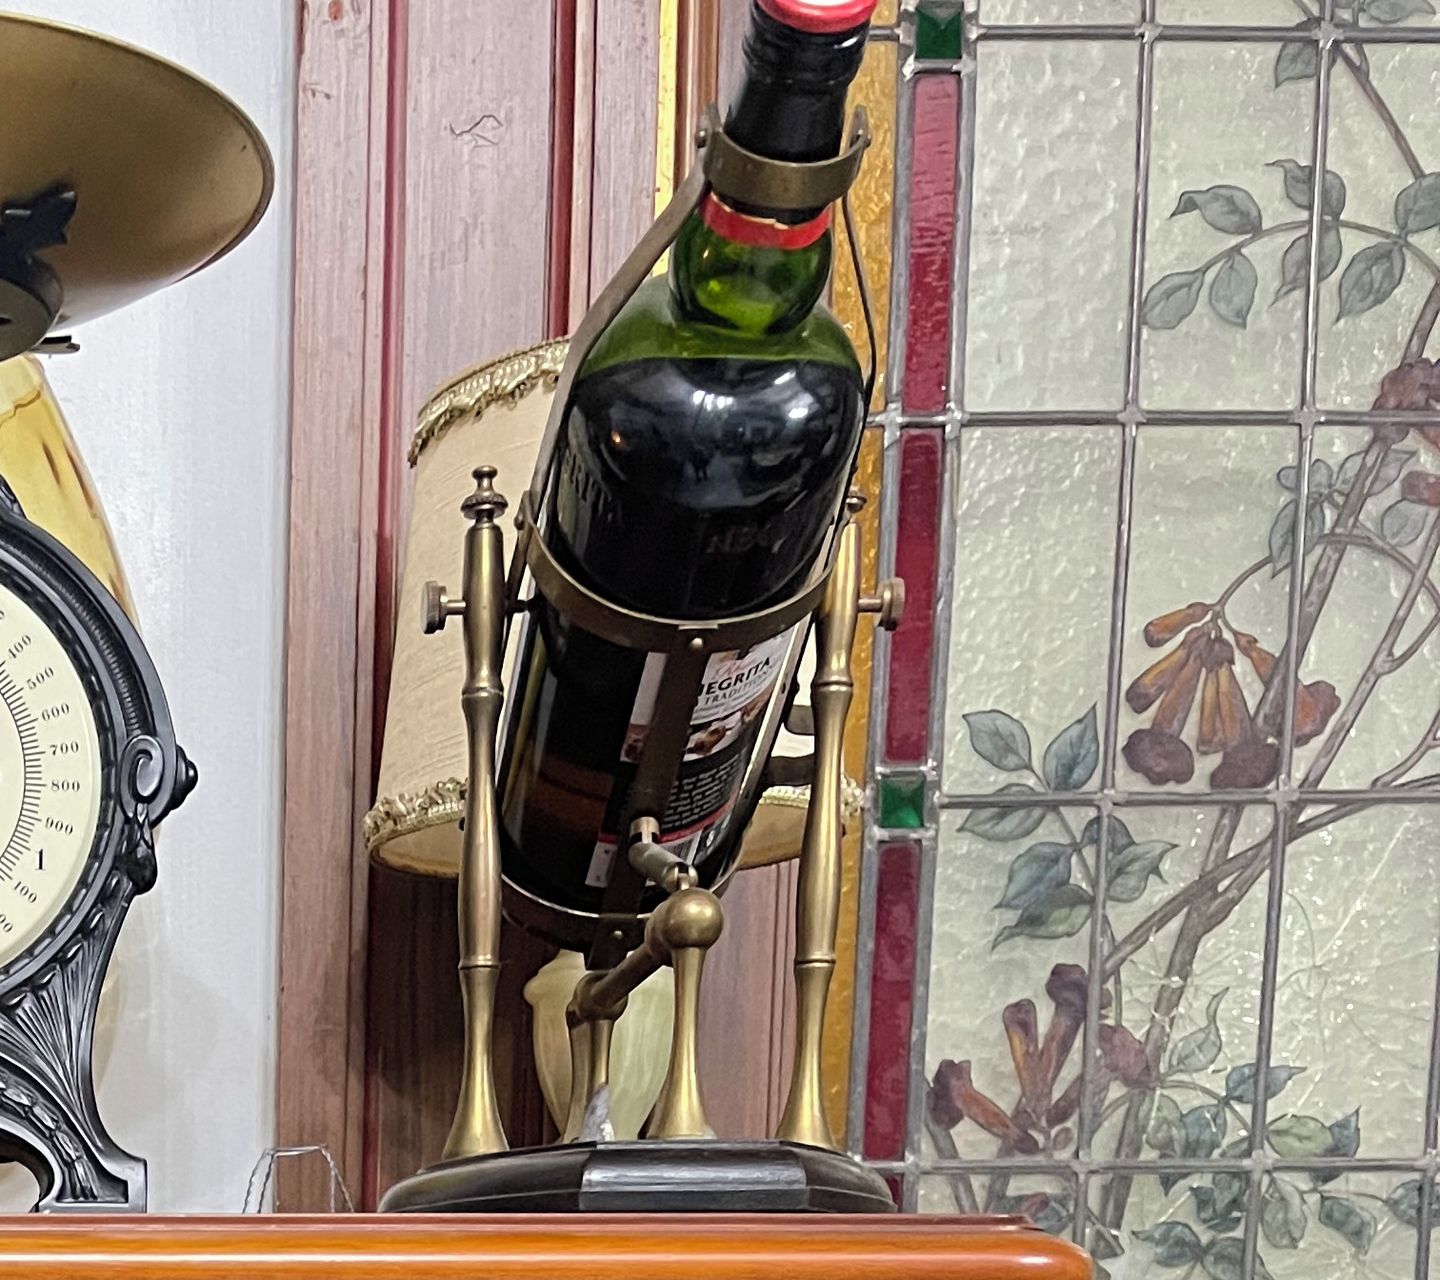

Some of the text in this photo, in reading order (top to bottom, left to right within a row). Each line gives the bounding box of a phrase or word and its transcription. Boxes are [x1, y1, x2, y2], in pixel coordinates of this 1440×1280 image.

[6, 634, 32, 662] 400
[26, 665, 55, 691] 500
[700, 656, 771, 697] EGRITA
[41, 702, 70, 721] 600
[50, 741, 79, 755] 700
[50, 780, 80, 792] 800
[45, 819, 74, 836] 900
[35, 849, 46, 871] 1
[14, 879, 38, 905] 100
